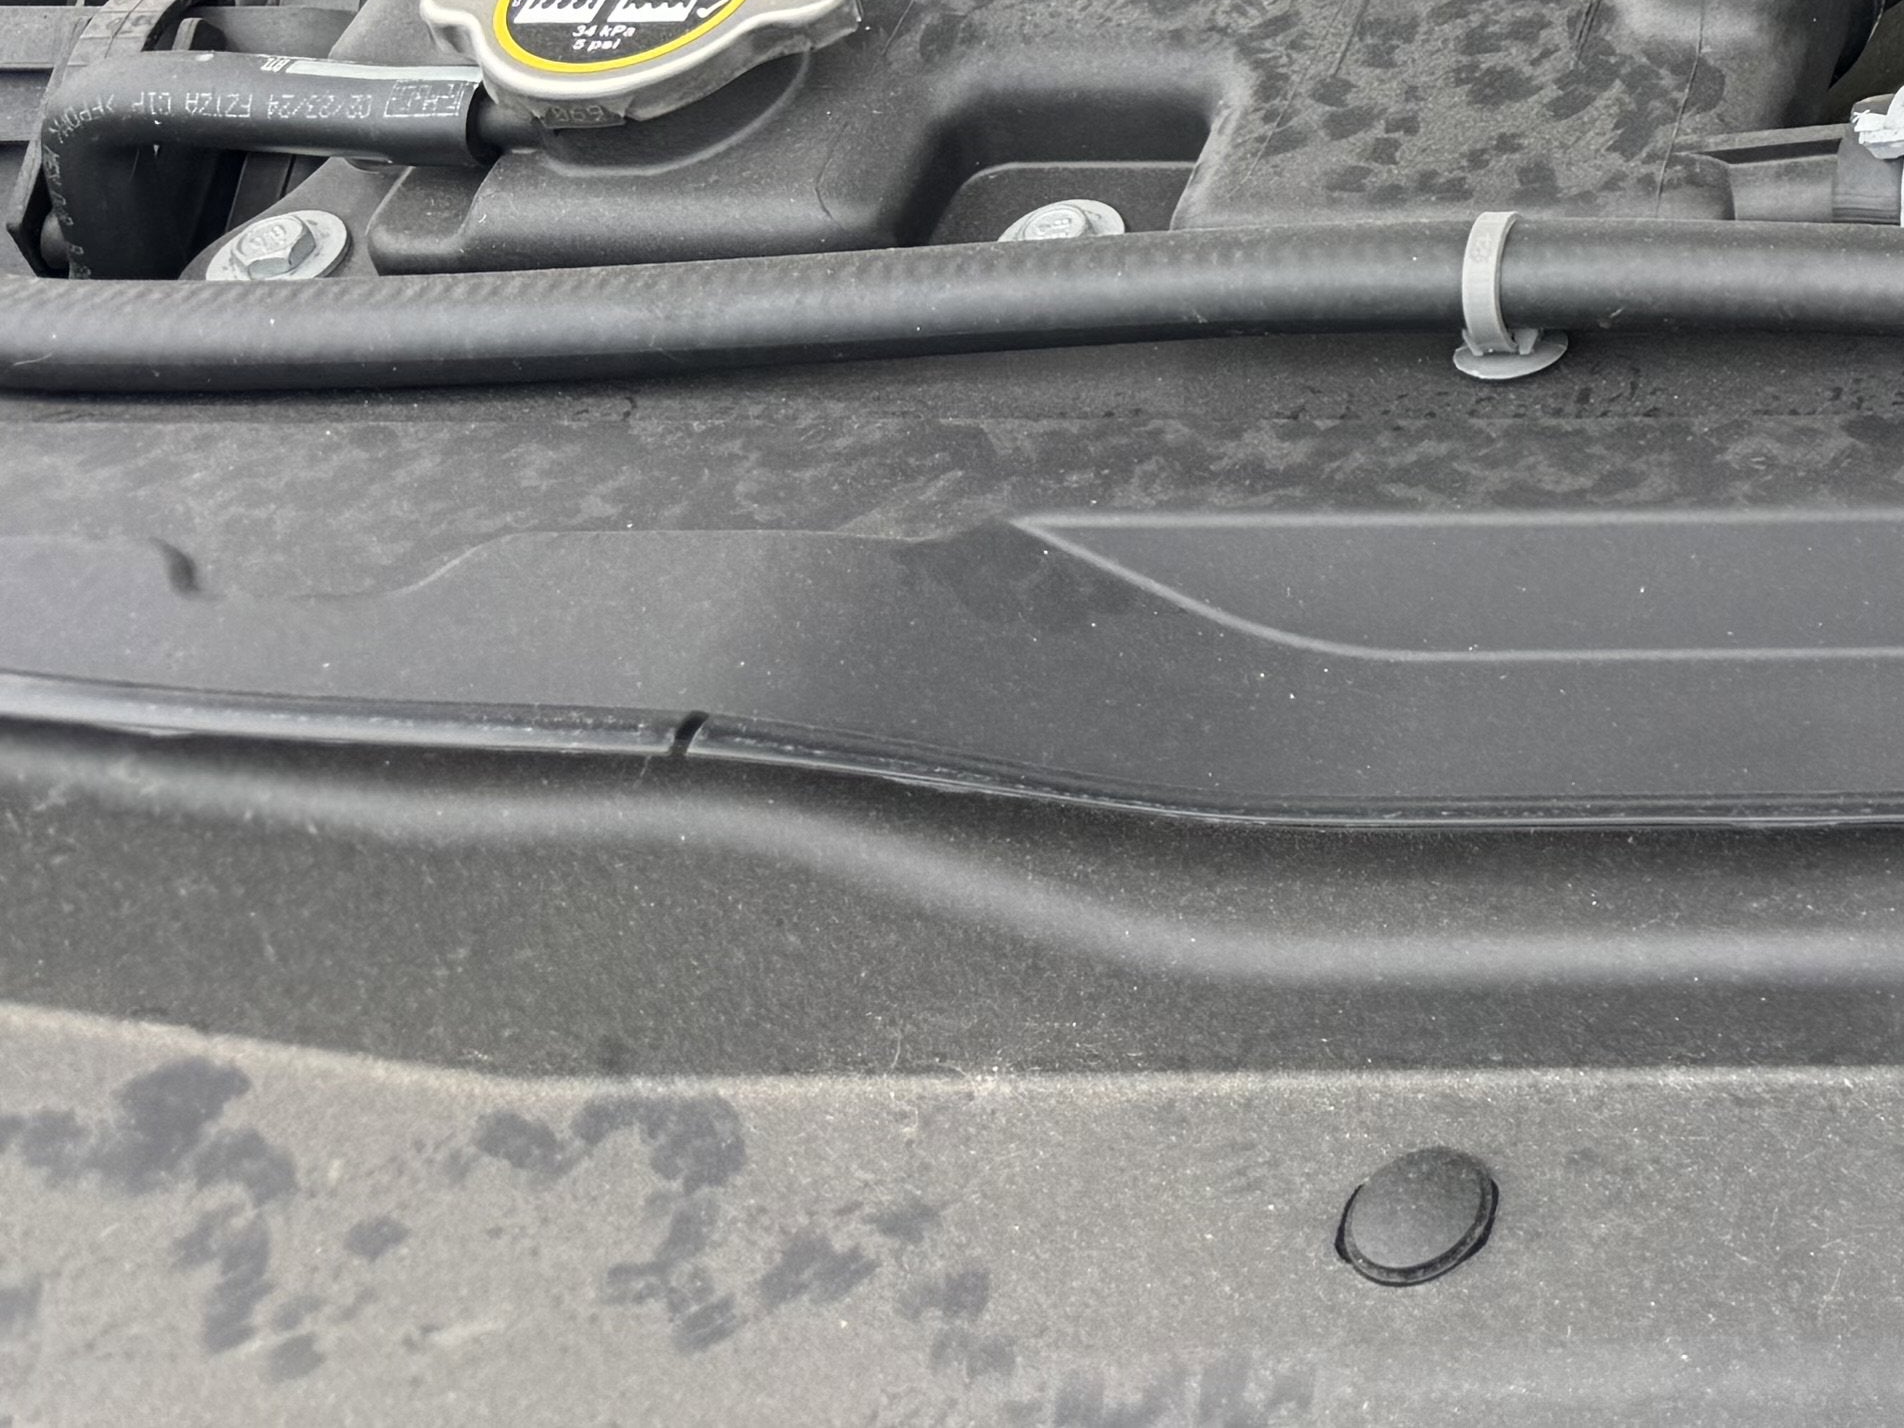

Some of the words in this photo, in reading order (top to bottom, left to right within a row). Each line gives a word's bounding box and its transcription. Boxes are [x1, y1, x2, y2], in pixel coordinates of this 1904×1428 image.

[572, 25, 599, 38] 34
[600, 24, 636, 38] kPa
[573, 37, 585, 51] 5
[586, 37, 622, 53] psi
